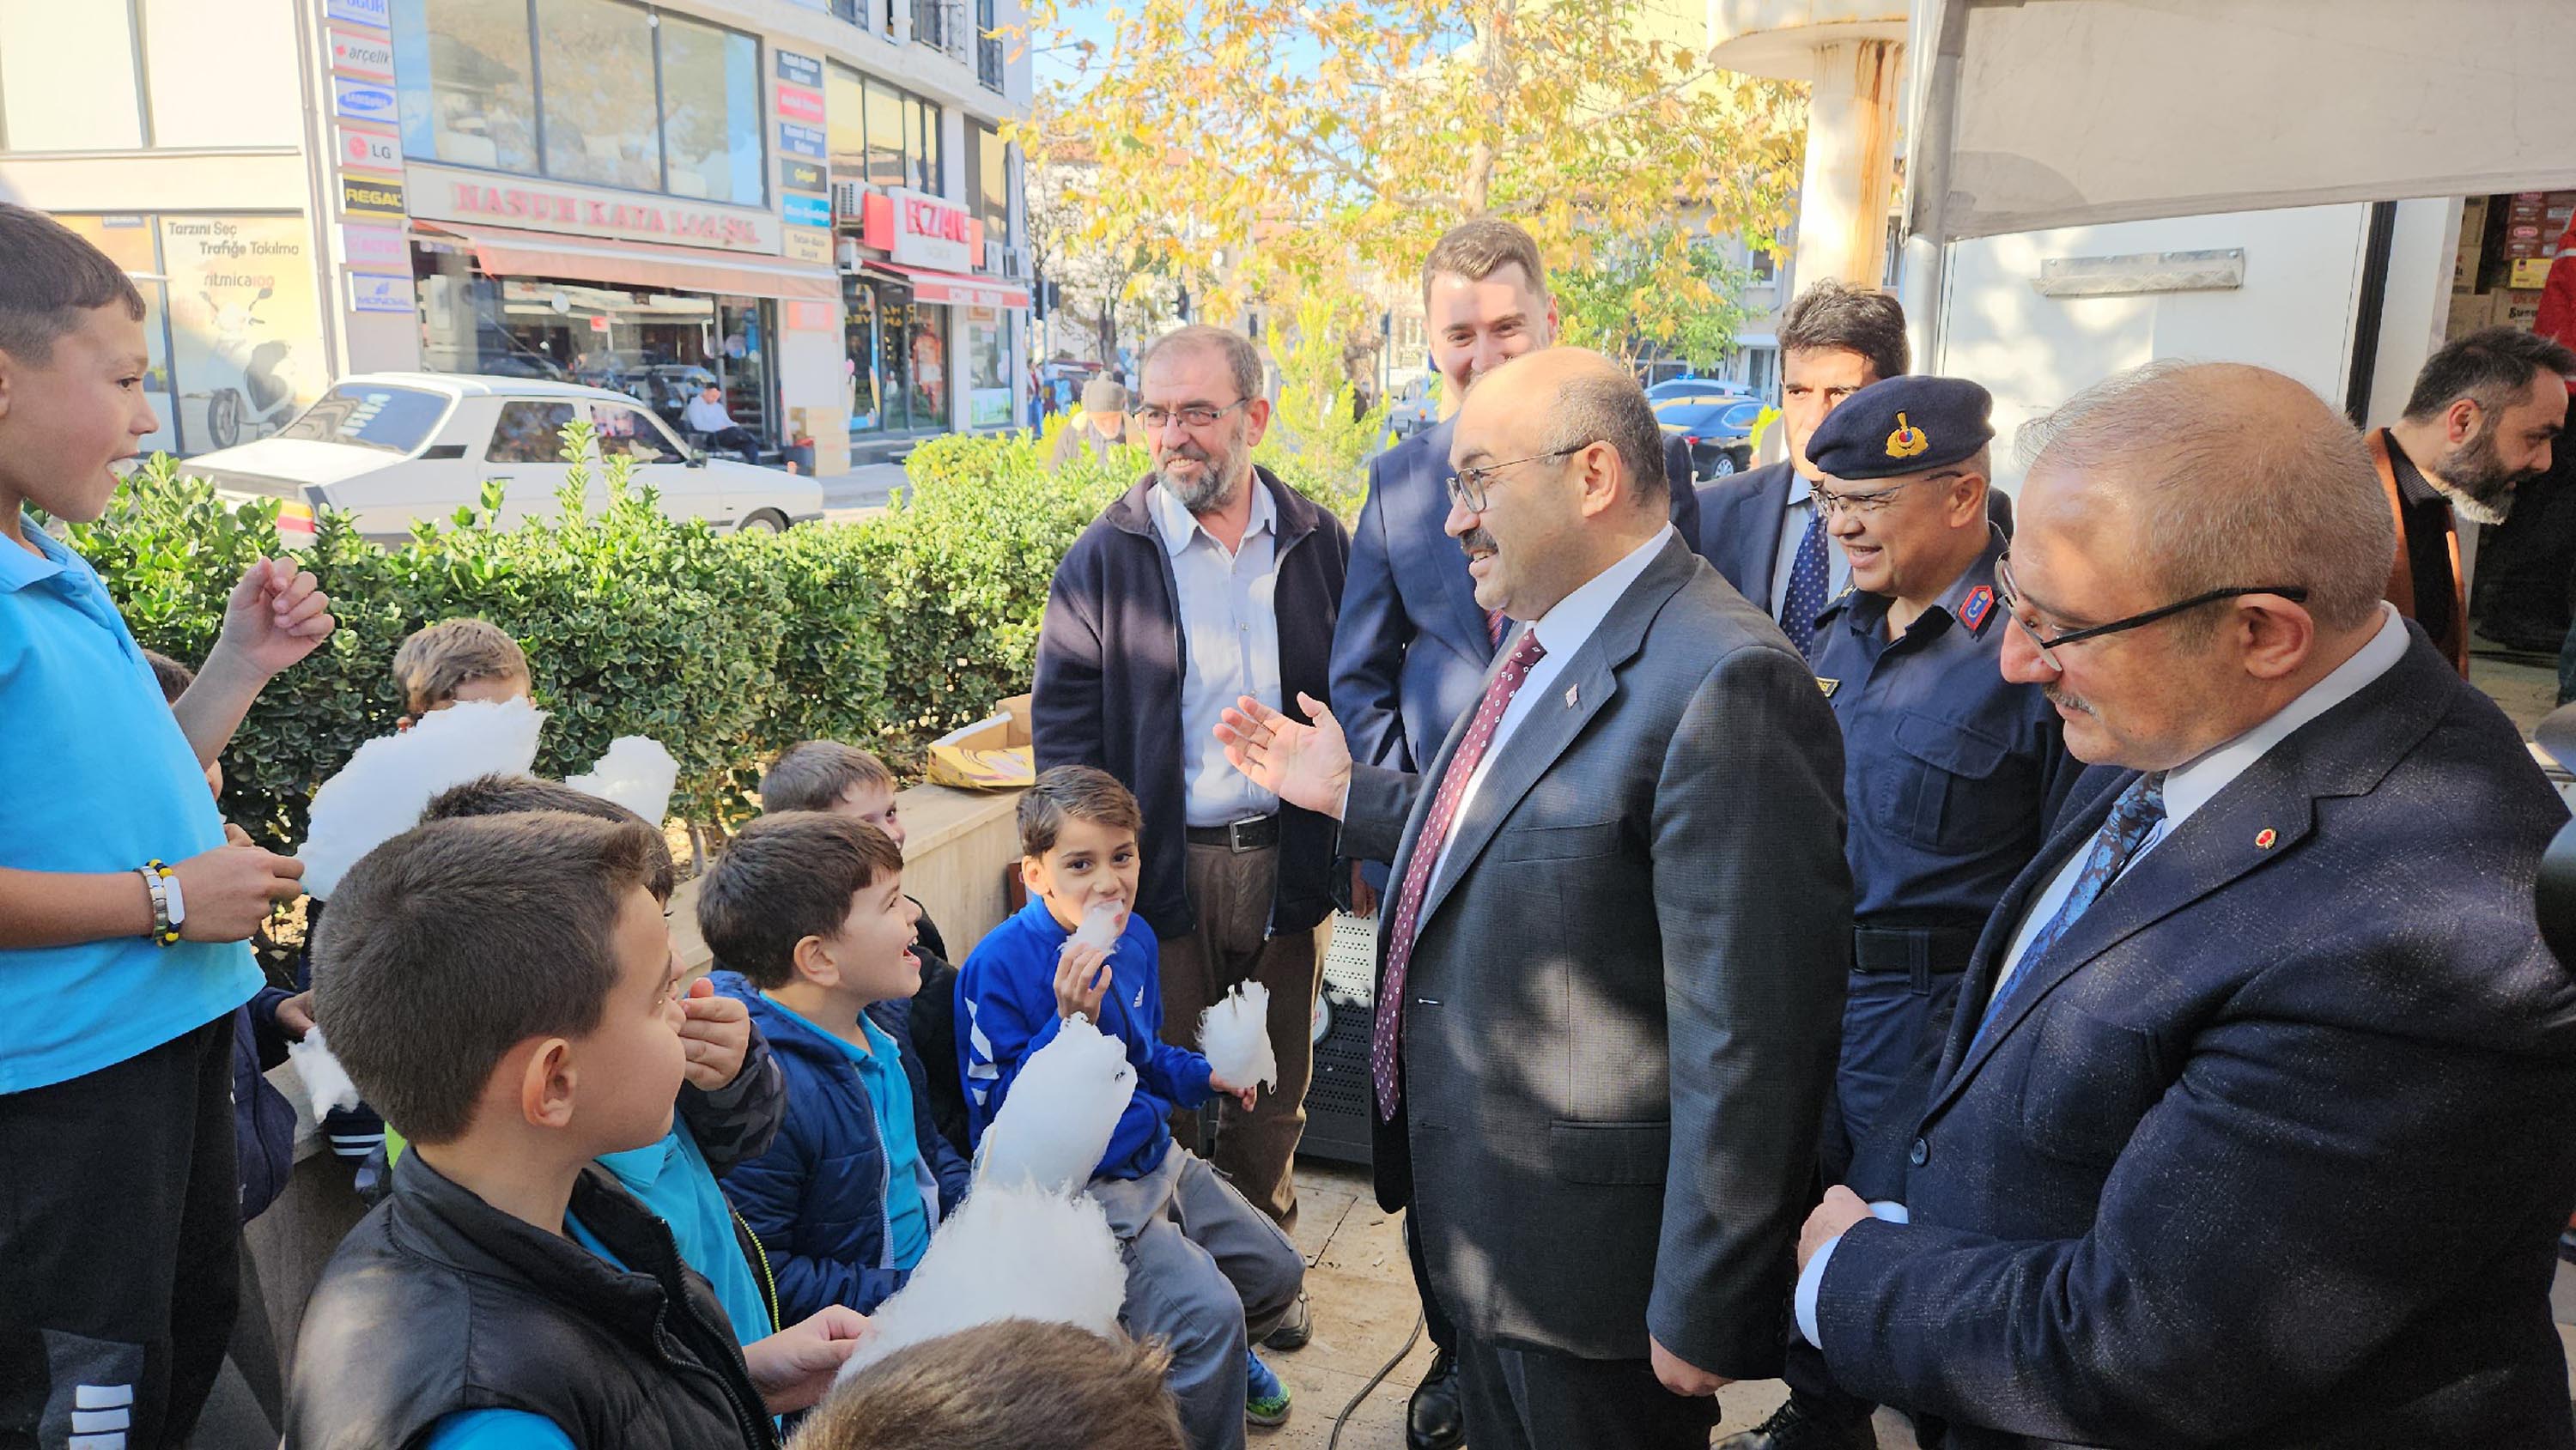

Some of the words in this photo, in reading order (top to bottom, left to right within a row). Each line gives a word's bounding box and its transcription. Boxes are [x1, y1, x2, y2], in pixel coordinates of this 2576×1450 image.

[348, 46, 392, 66] arçelik
[371, 143, 392, 159] LG
[345, 187, 403, 208] REGAL
[455, 184, 578, 223] NASUH
[585, 201, 666, 234] KAYA
[213, 221, 238, 239] Seç
